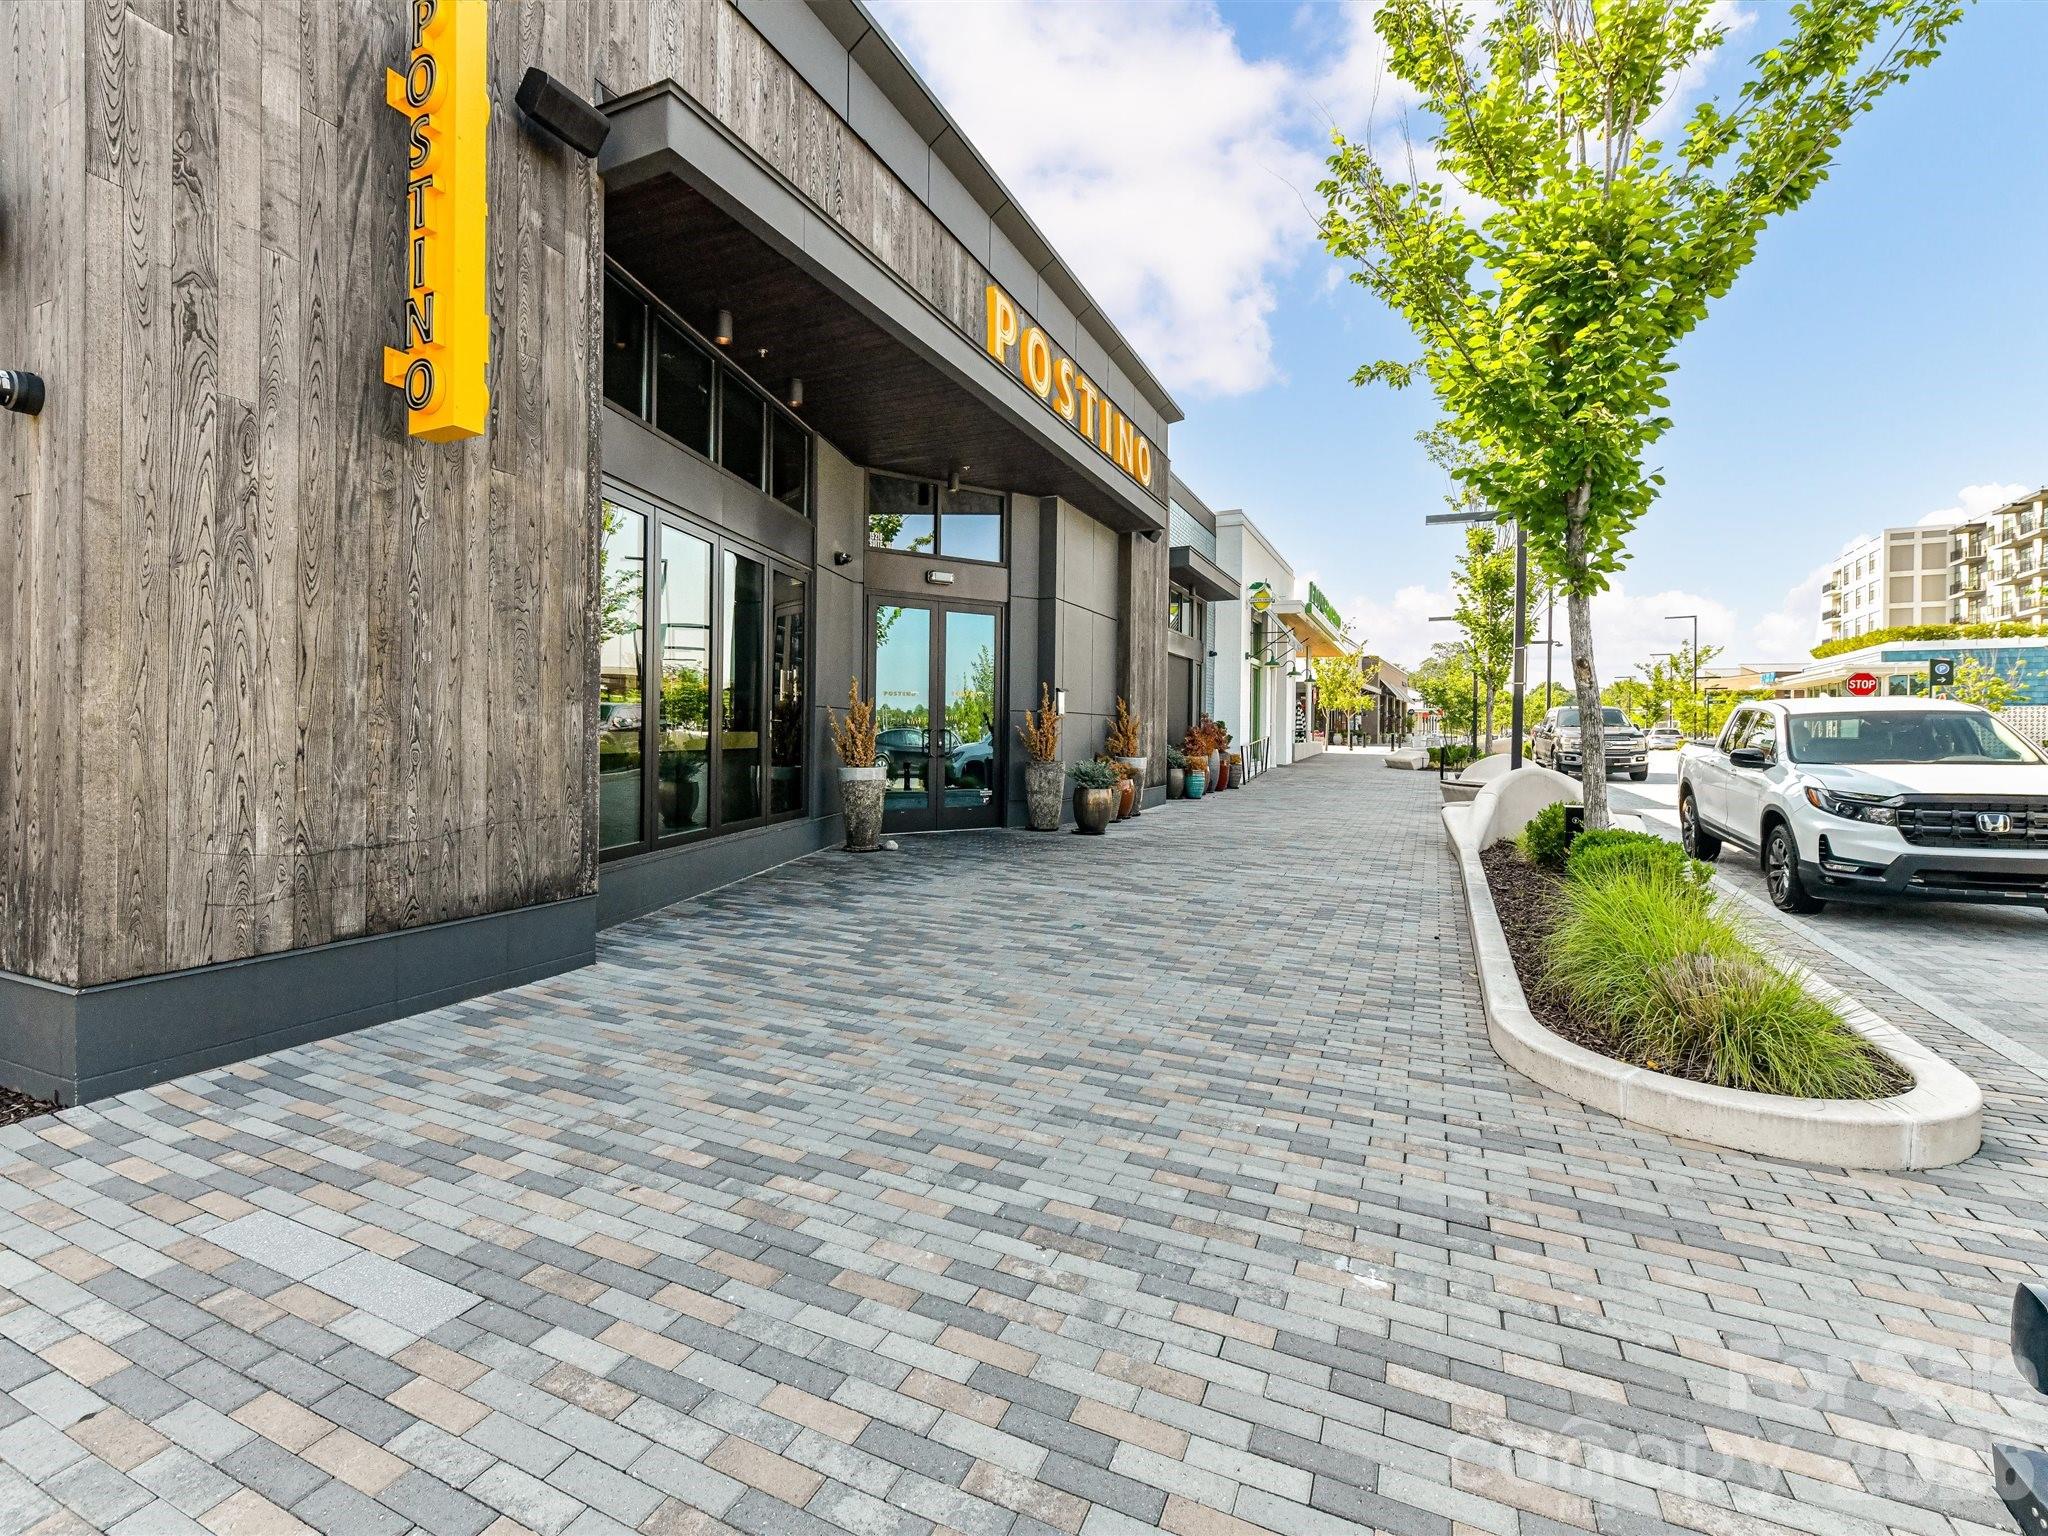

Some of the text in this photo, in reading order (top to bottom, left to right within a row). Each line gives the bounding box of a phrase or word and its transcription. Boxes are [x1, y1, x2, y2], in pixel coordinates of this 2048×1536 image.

[404, 0, 437, 411] POSTINO
[986, 283, 1152, 487] POSTINO
[1849, 680, 1876, 689] STOP
